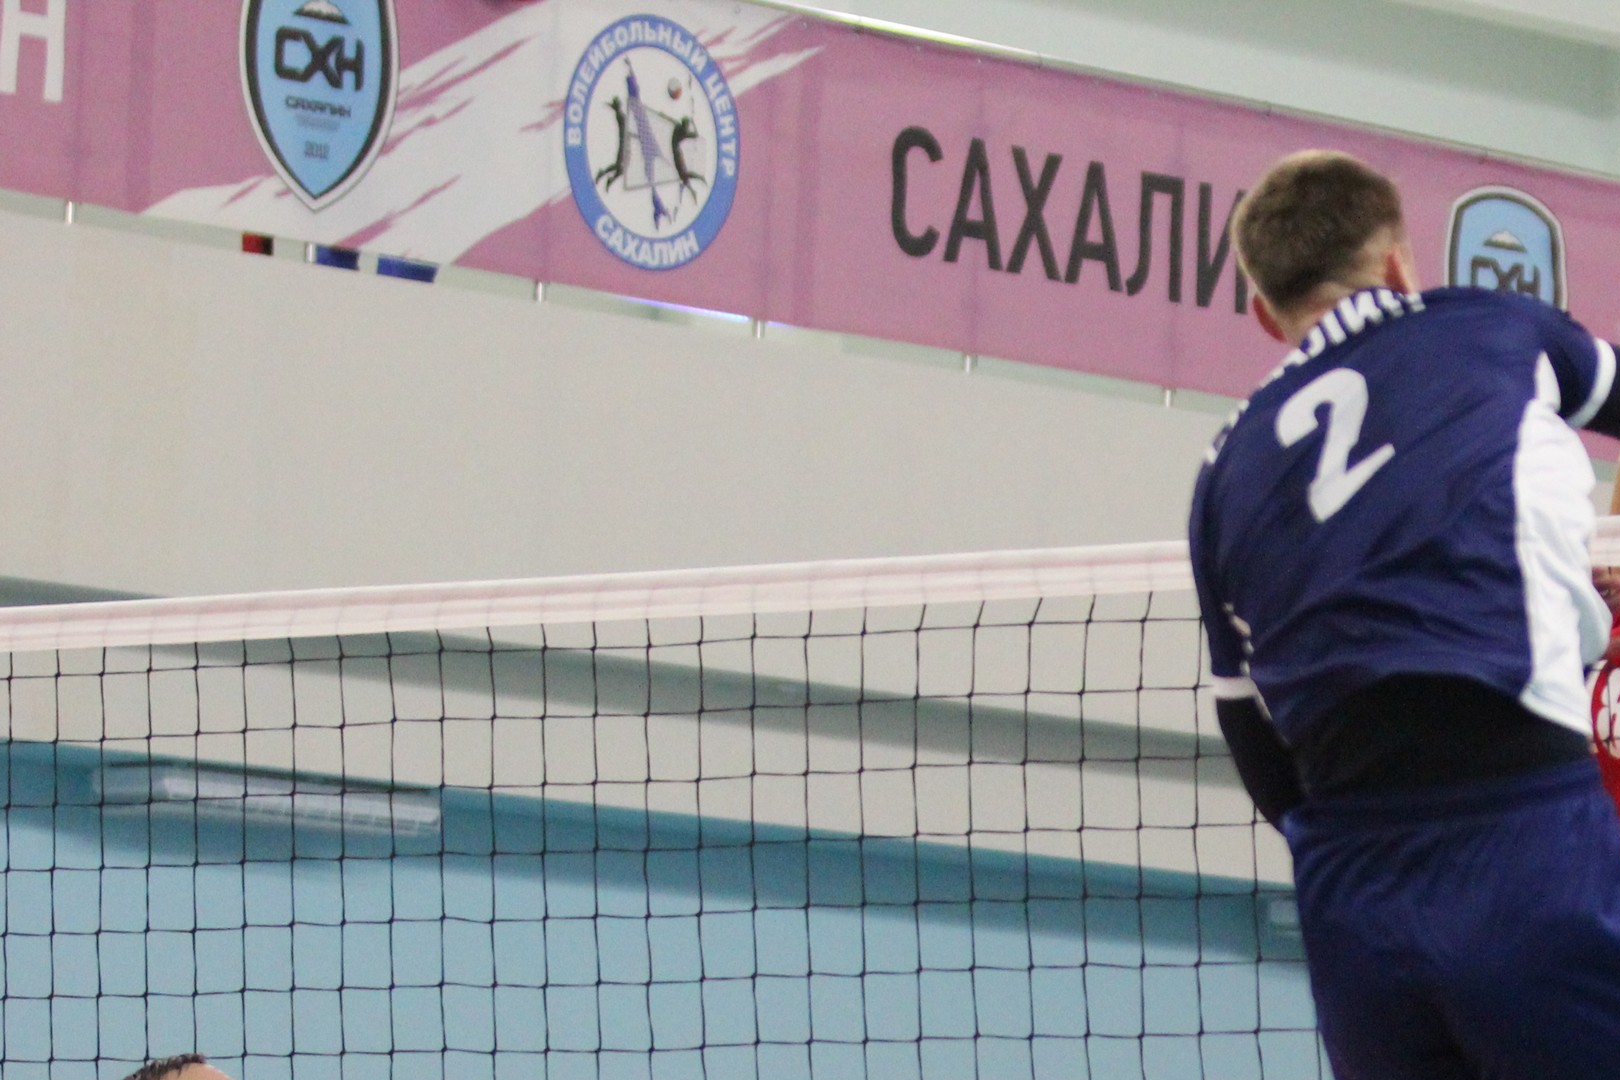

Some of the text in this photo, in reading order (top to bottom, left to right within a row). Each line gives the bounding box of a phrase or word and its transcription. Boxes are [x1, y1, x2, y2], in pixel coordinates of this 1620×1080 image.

[704, 72, 738, 178] ЦЕНТР
[595, 213, 701, 268] САХАЛИН
[891, 126, 1250, 315] САХАЛИ
[1274, 366, 1396, 524] 2
